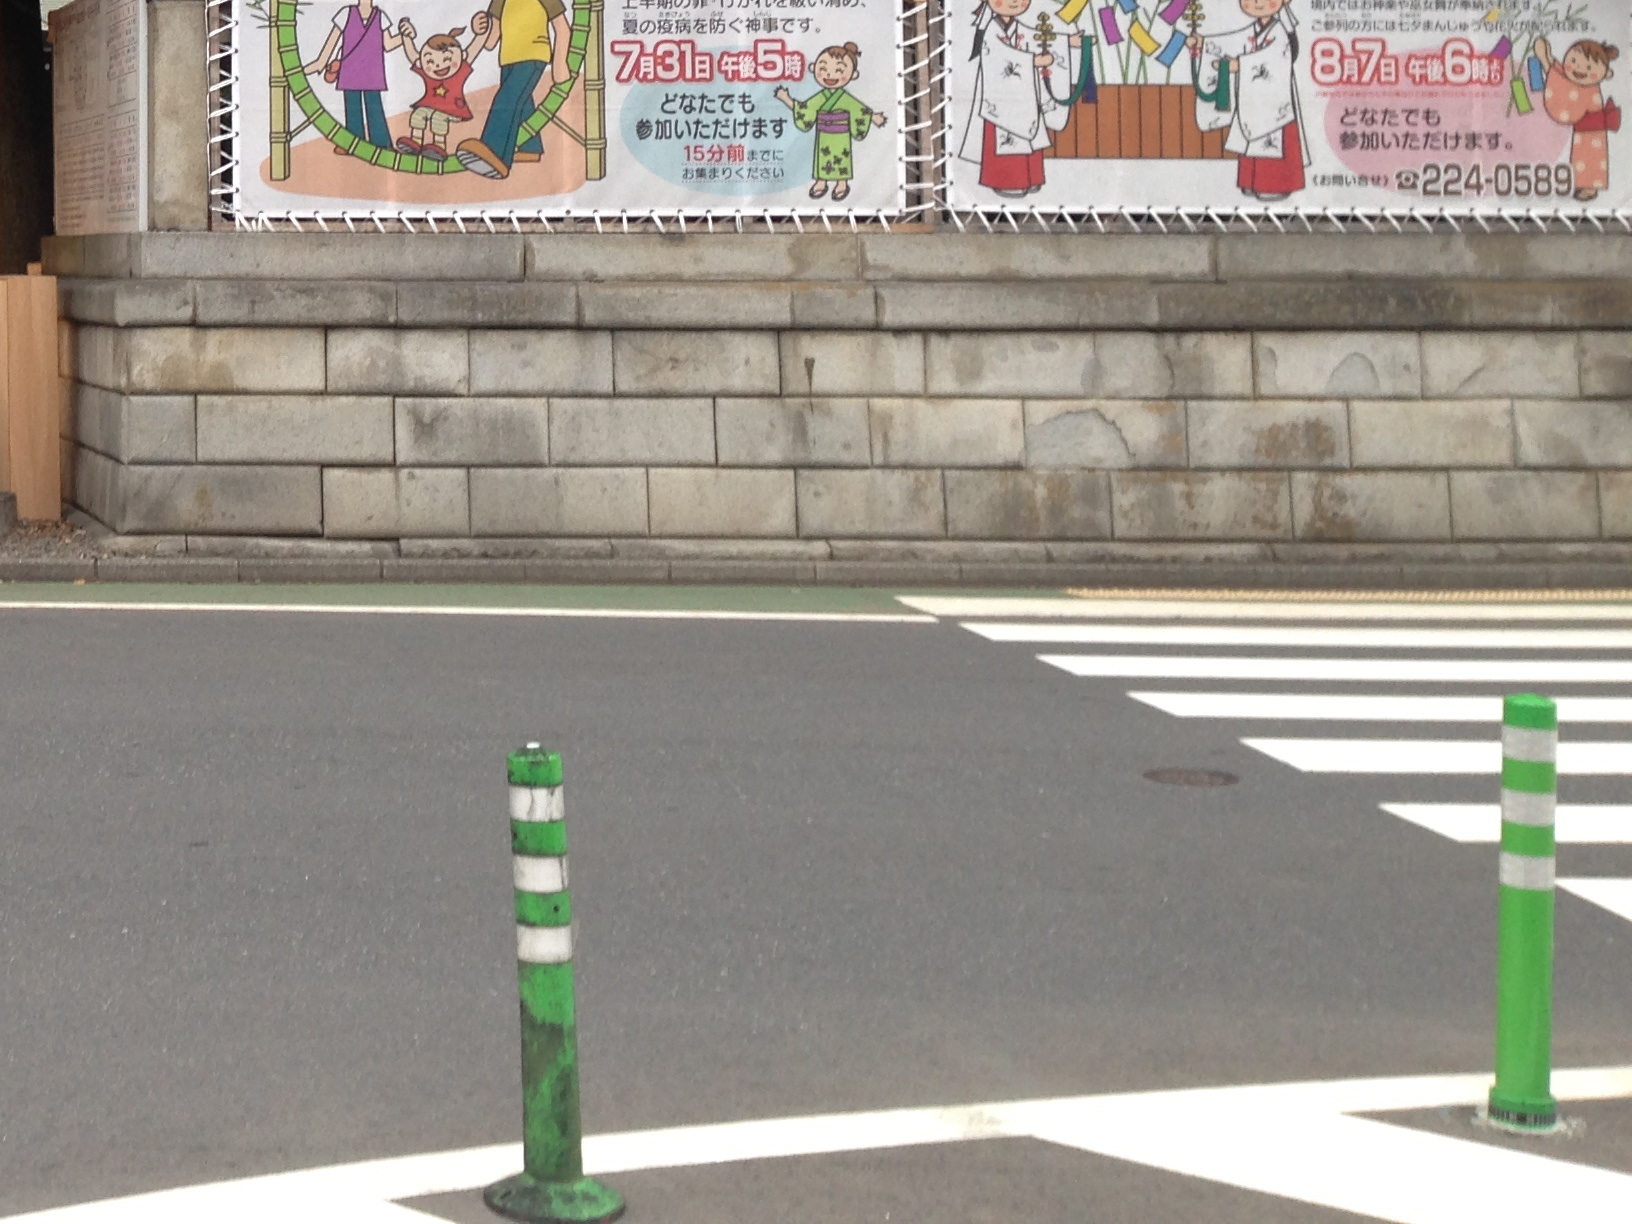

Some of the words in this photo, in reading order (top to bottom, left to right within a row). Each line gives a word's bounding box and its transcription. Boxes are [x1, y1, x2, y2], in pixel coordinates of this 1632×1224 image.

[621, 17, 821, 35] 夏の疫病を防ぐ神事です。
[613, 40, 713, 84] 7月31日
[718, 40, 805, 82] 午後5時
[1312, 37, 1398, 85] 8月7日
[659, 92, 755, 114] どなたでも
[1340, 107, 1441, 126] どなたでも
[635, 117, 788, 140] 参加いただけます
[1339, 131, 1513, 151] 参加いただけます。
[682, 167, 784, 181] お集まりください
[1421, 162, 1573, 197] 224-0589
